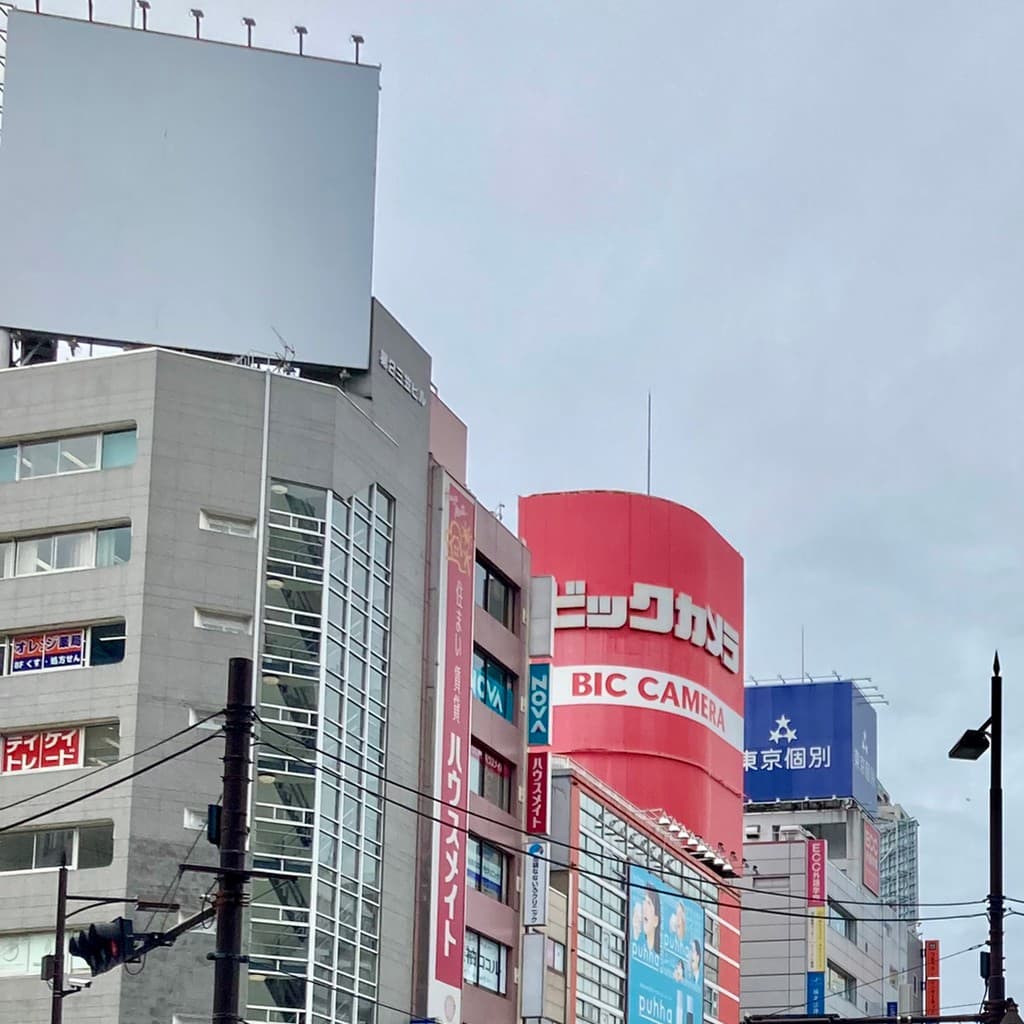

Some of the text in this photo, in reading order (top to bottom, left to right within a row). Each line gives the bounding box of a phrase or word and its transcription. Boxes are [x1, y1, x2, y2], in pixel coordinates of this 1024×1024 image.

[552, 581, 740, 675] ビックカメラ
[531, 676, 547, 732] NOVA
[571, 672, 726, 733] BIC CAMERA
[743, 746, 831, 772] 東京個別
[531, 757, 544, 829] ハウスメイト
[441, 732, 463, 957] ハウスメイト
